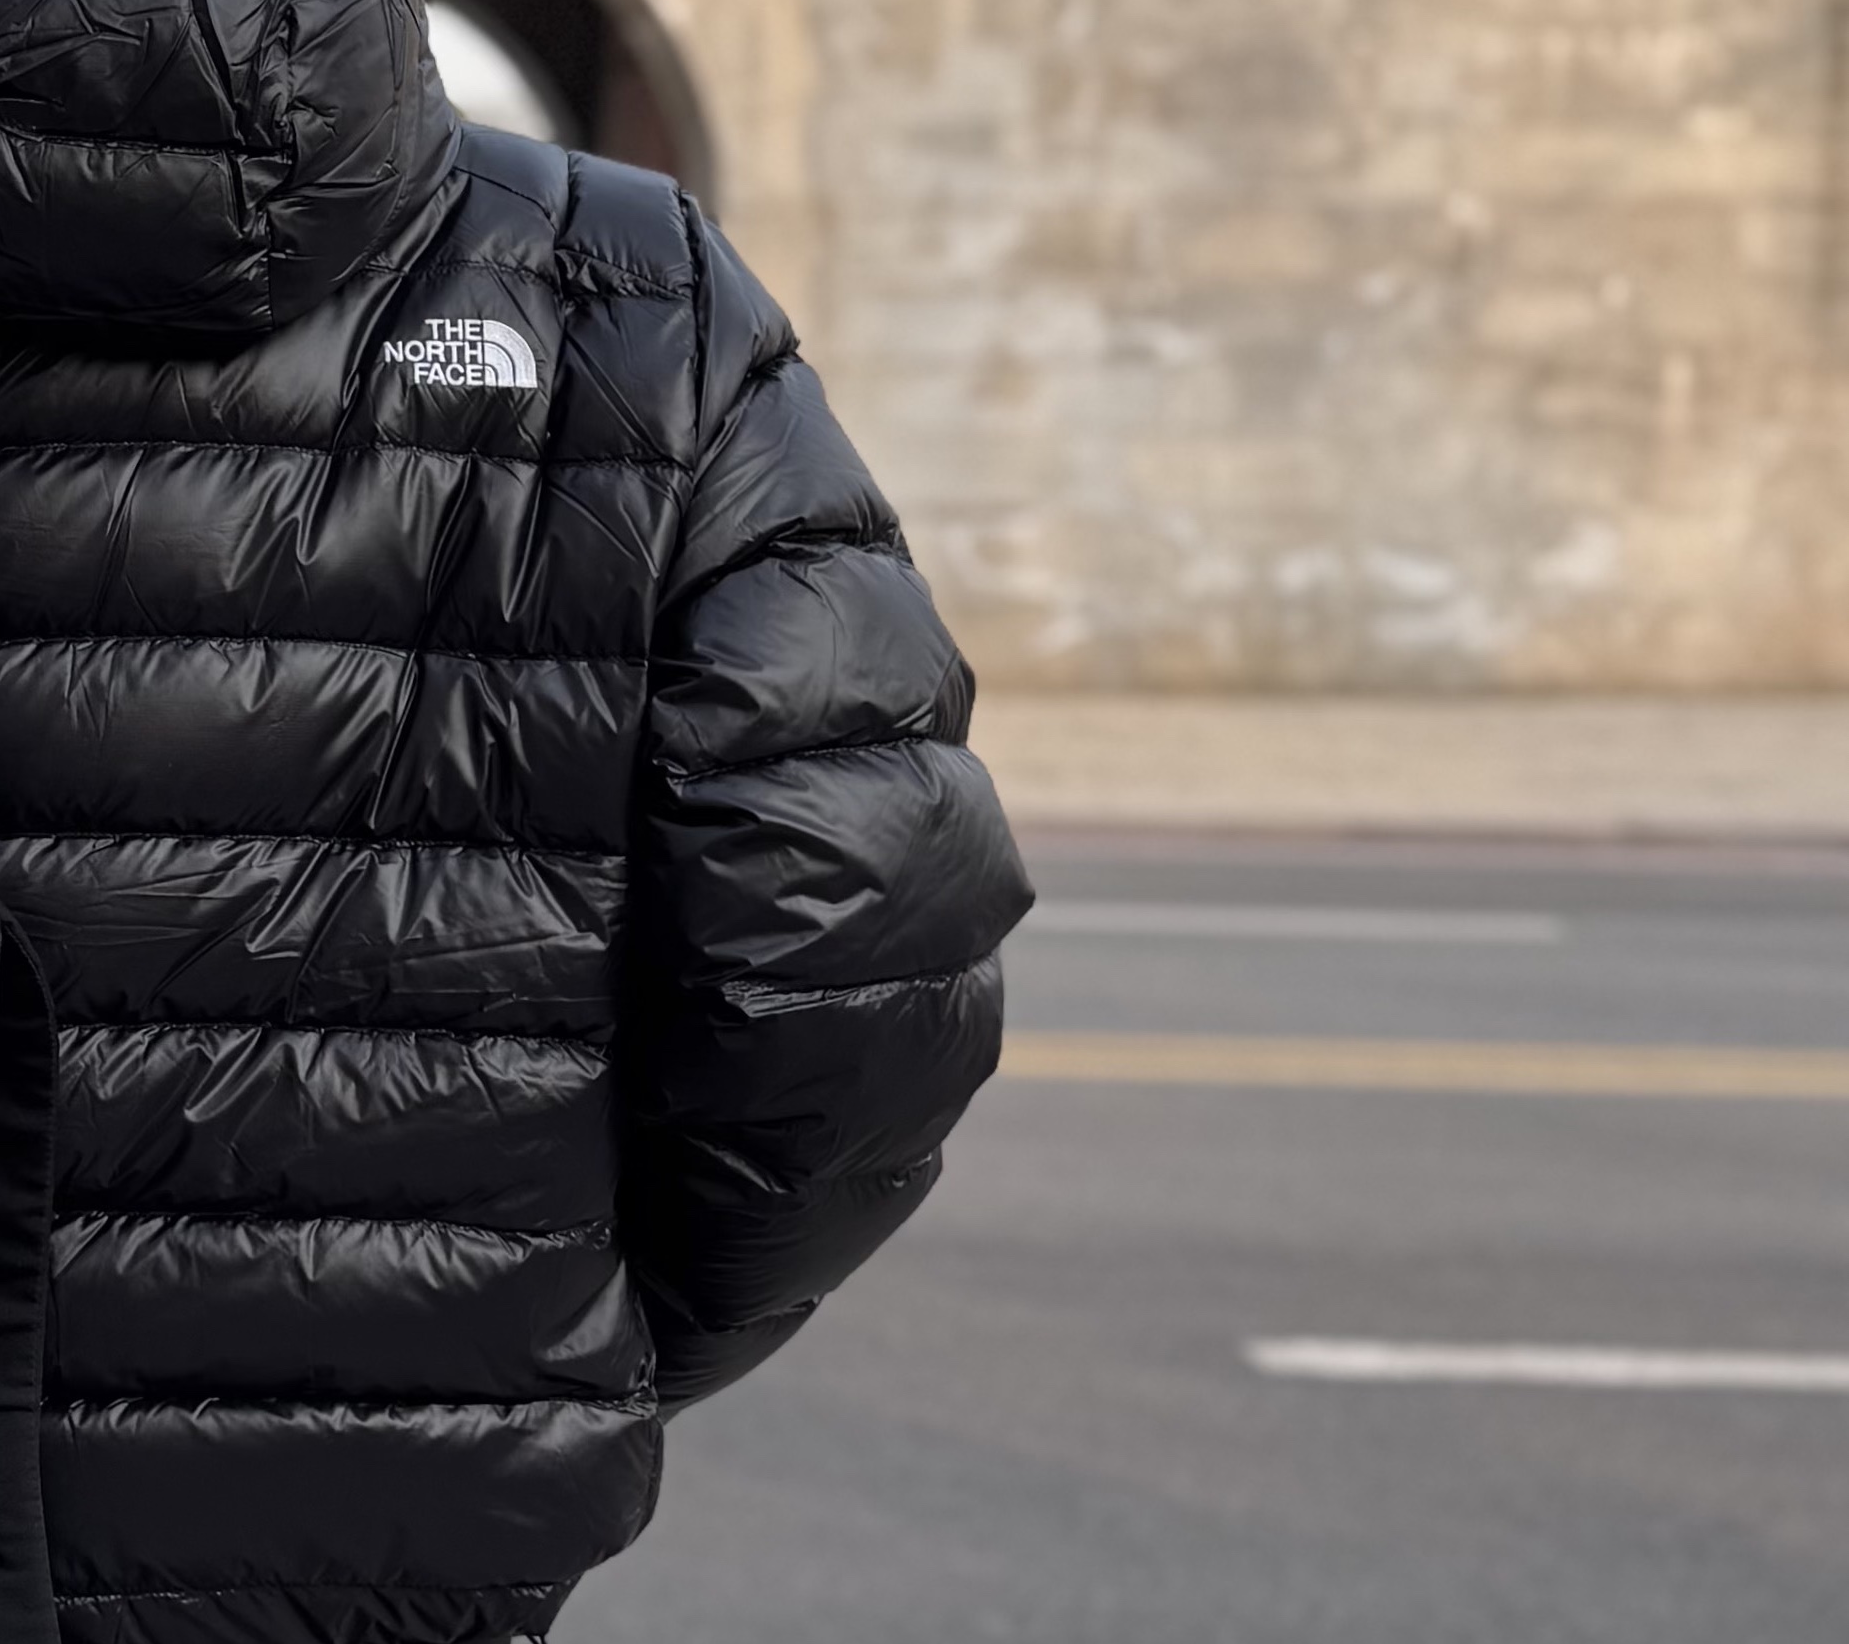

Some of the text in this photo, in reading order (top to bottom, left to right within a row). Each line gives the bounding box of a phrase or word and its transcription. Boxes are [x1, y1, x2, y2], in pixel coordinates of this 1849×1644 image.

[424, 318, 482, 340] THE
[383, 341, 483, 364] NORTH
[414, 363, 484, 386] FACE
